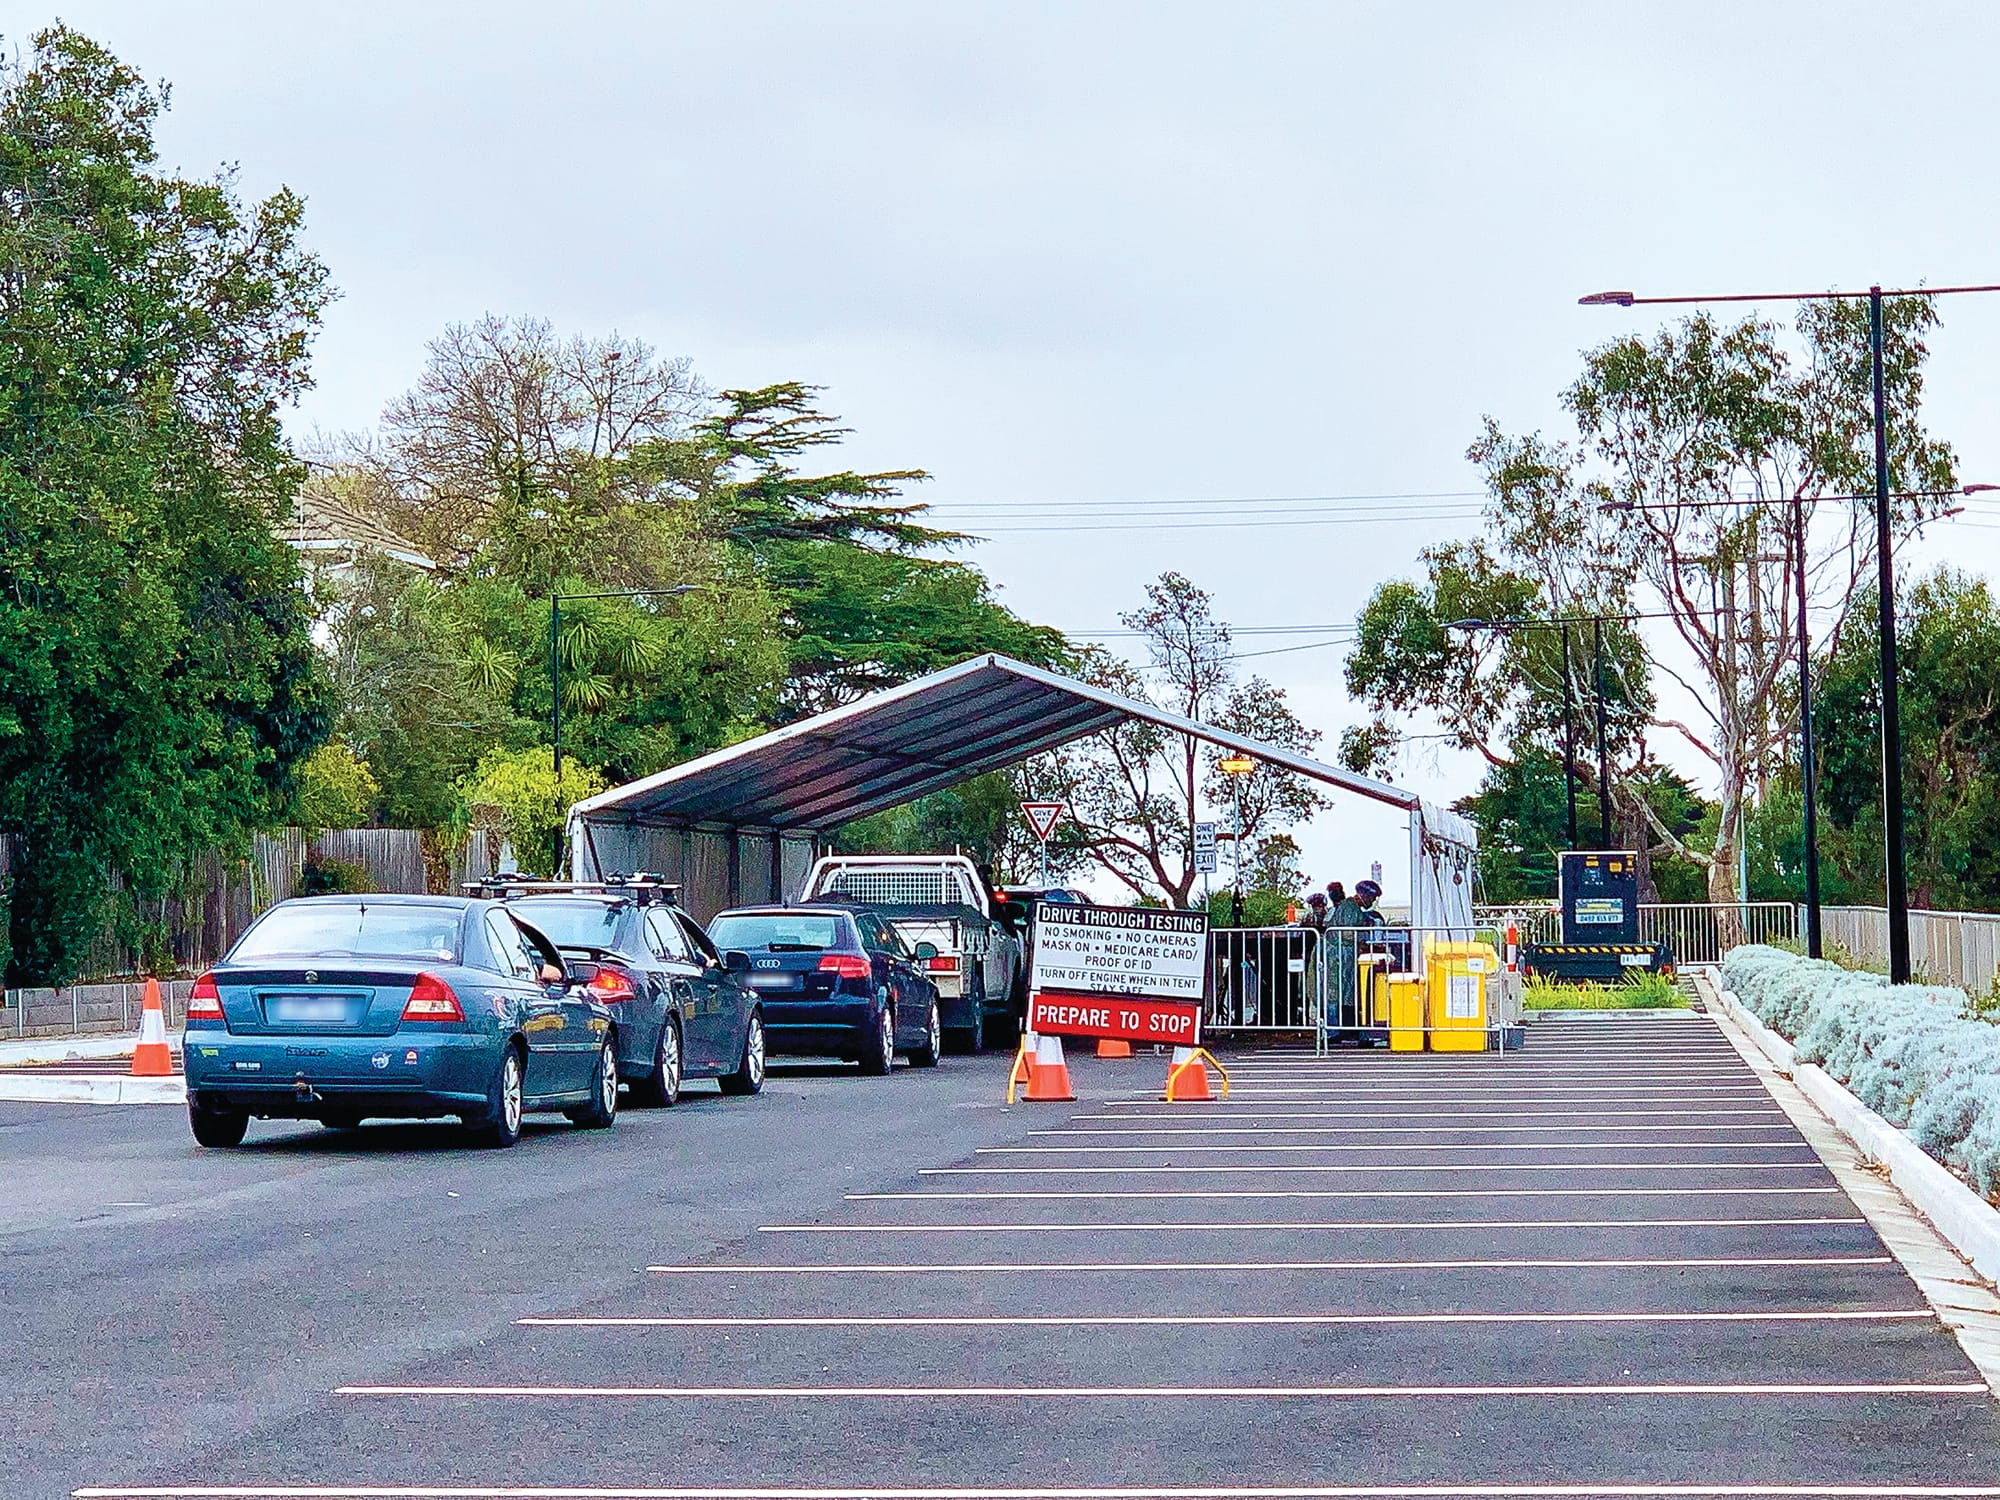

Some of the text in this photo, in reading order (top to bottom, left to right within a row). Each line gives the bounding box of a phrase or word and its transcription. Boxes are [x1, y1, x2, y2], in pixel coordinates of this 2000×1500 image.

[1196, 855, 1213, 863] EXIT
[1042, 908, 1202, 932] DRIVE THROUGH TESTING
[1045, 927, 1196, 947] NO SMOKING NO CAMERAS
[1042, 940, 1197, 961] MASK ON MEDICARE CARD/
[1085, 956, 1152, 970] PROOF OF ID
[1040, 969, 1196, 988] TURN OFF ENGINE WHEN IN TENT
[1037, 1005, 1191, 1033] PREPARE TO STOP
